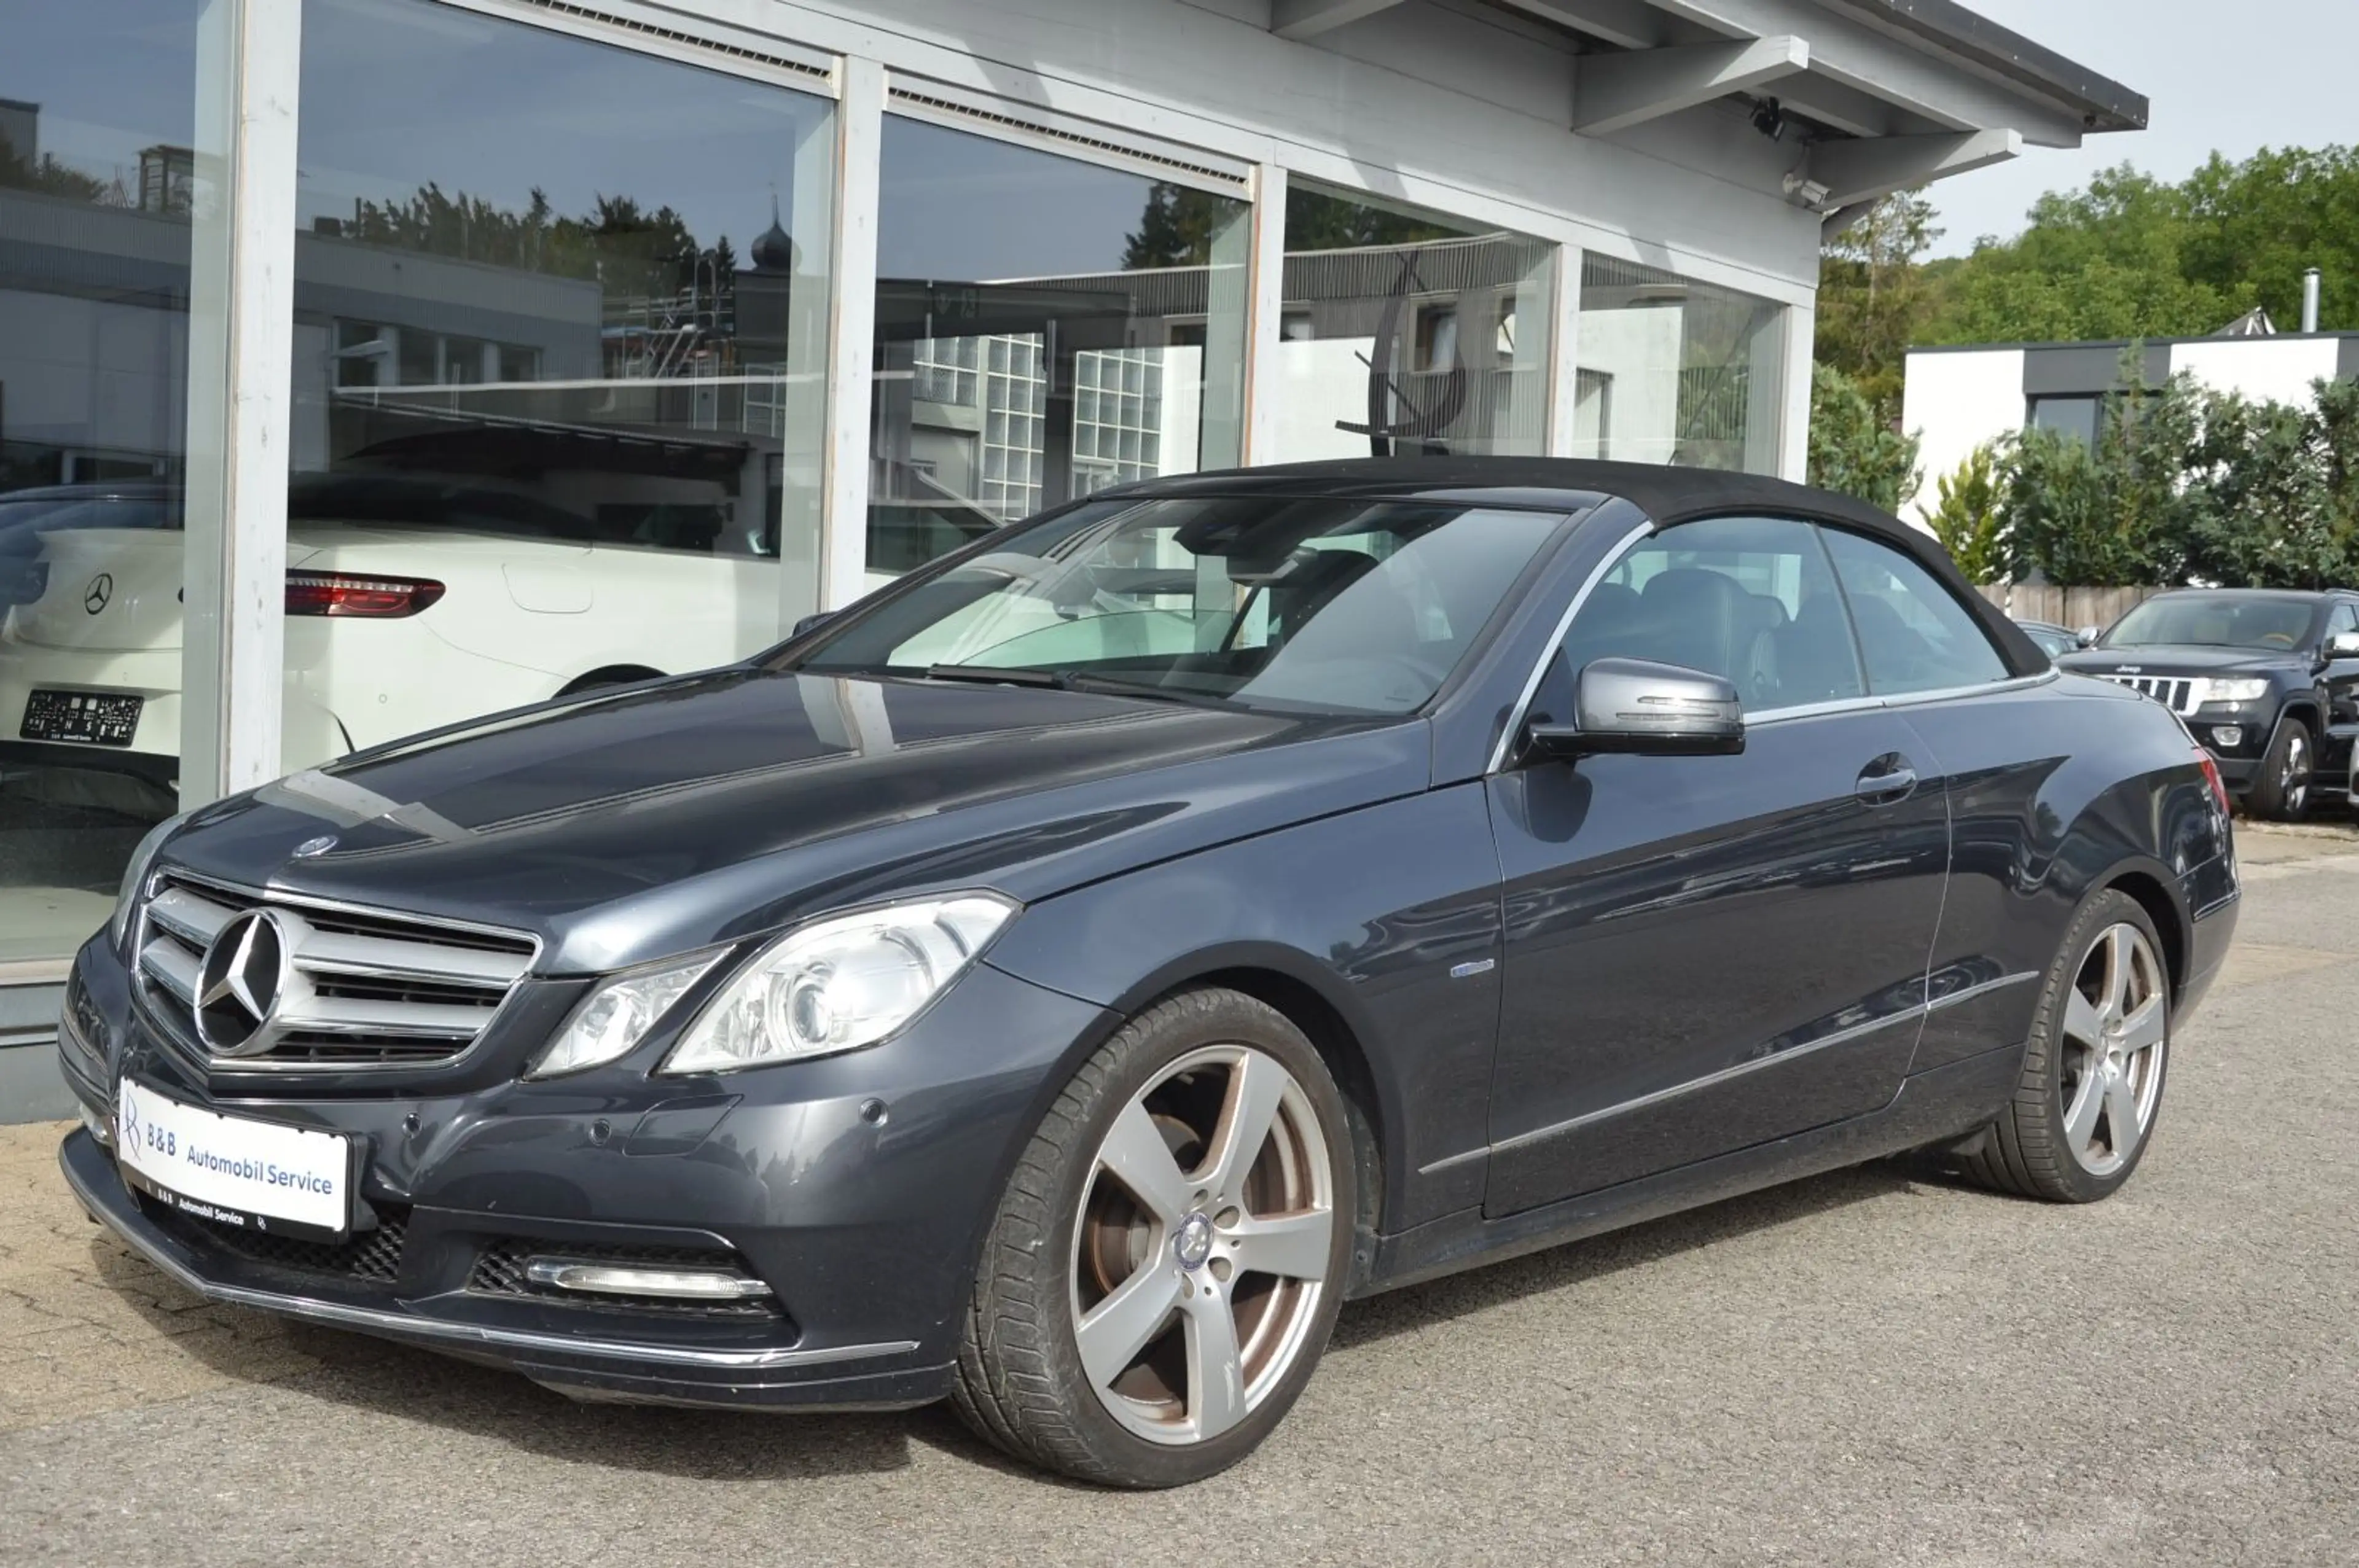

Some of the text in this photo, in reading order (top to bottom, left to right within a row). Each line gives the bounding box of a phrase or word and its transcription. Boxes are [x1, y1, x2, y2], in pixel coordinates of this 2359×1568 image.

[147, 1123, 332, 1195] B&B Automobil Service
[179, 1198, 213, 1218] Automobil
[215, 1209, 244, 1226] Service
